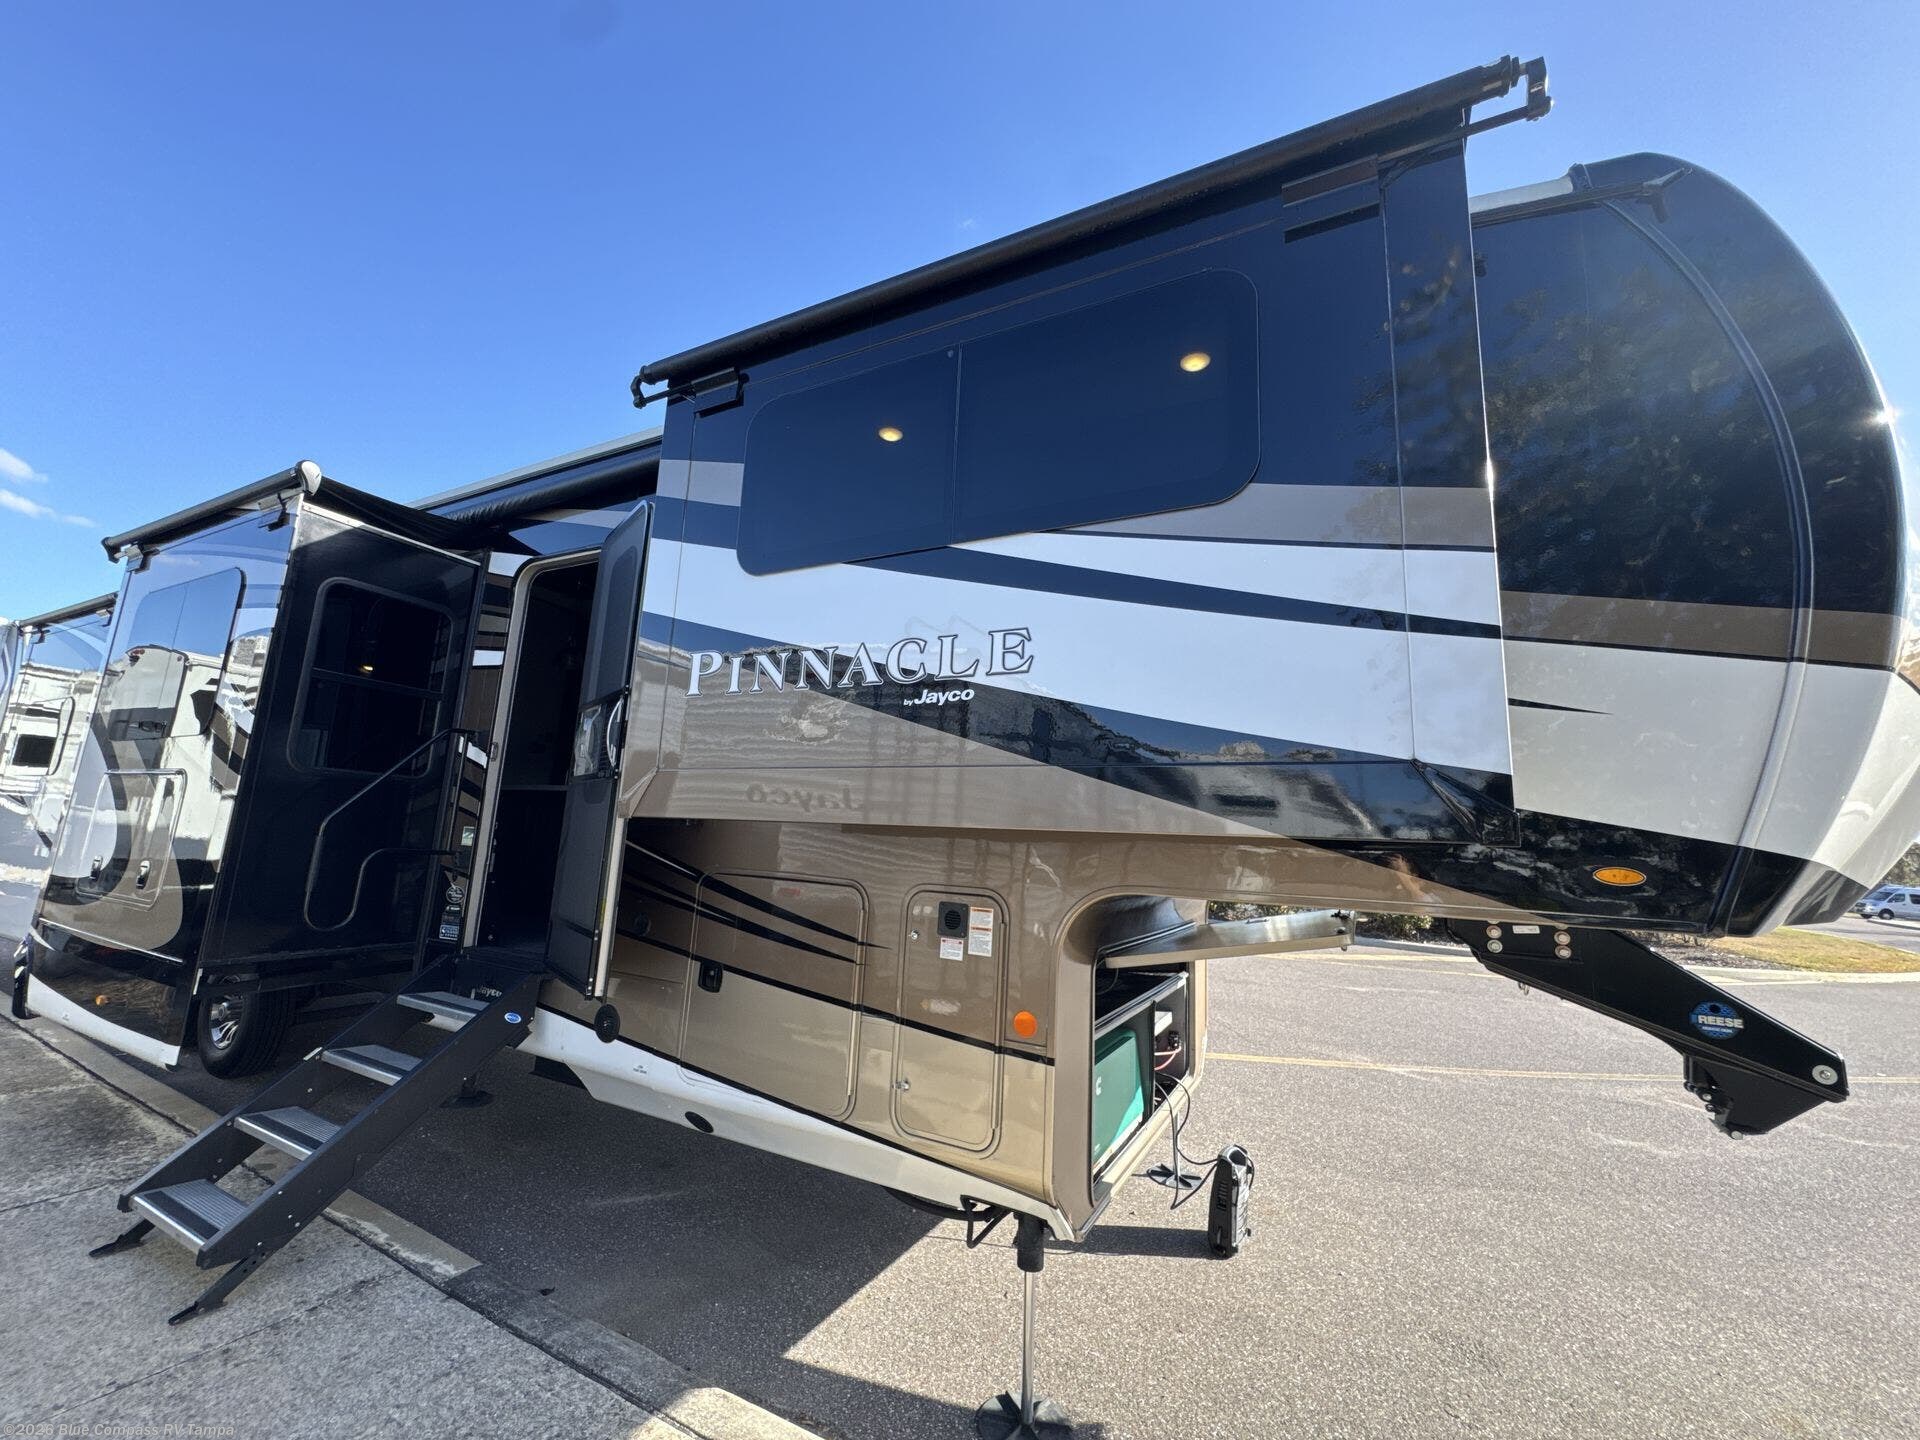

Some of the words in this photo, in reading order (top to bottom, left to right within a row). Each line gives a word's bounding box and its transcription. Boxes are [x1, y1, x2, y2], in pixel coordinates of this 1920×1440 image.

[685, 627, 1034, 697] PINNACLE
[914, 689, 975, 706] Jayco
[1697, 1015, 1744, 1029] REESE
